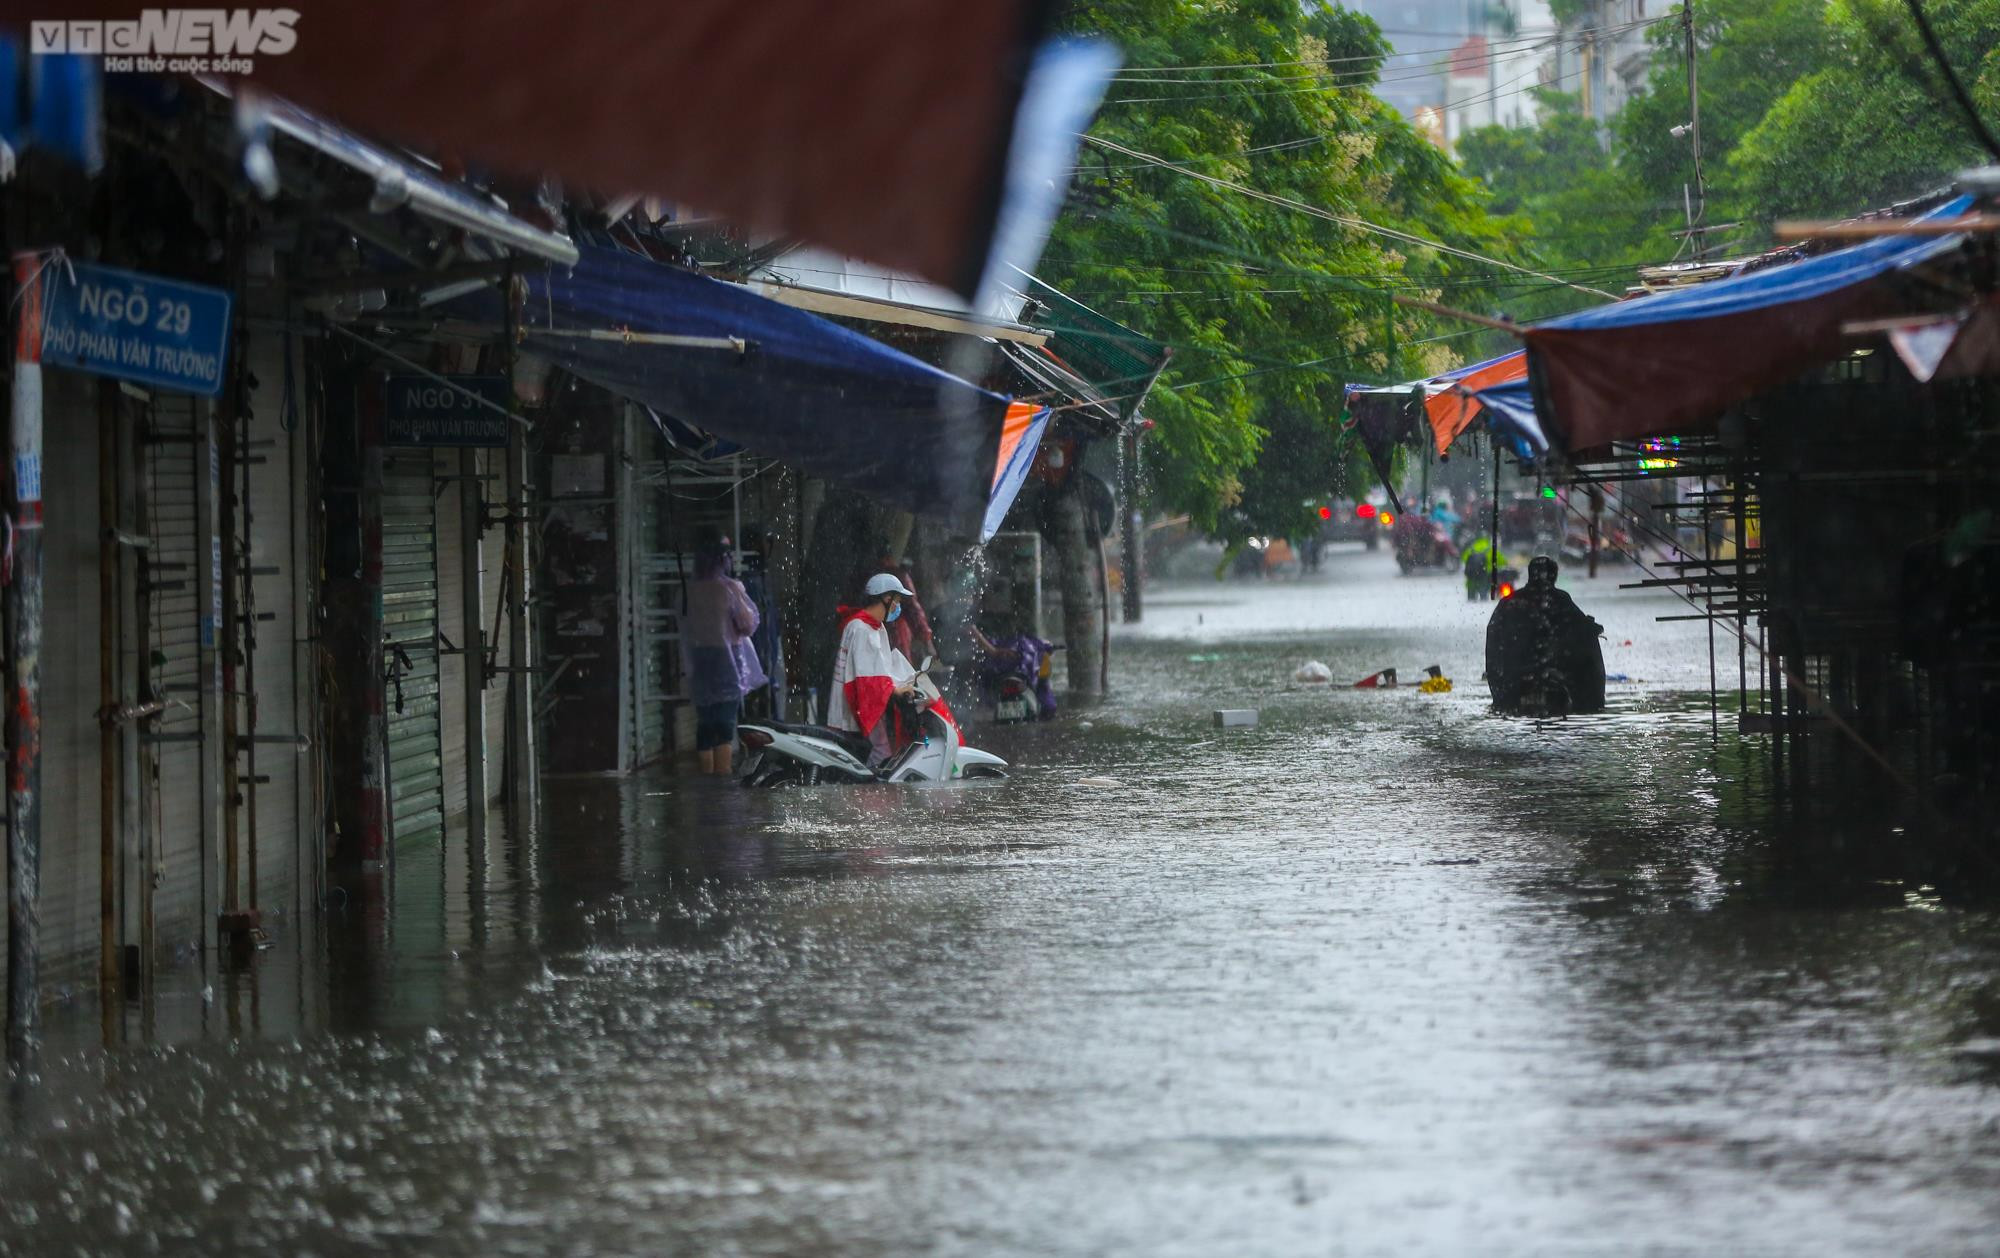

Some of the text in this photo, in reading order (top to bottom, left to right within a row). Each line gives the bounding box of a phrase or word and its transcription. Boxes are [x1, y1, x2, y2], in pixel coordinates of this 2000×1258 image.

[79, 281, 192, 335] NGÕ 29
[78, 329, 119, 363] PHAN
